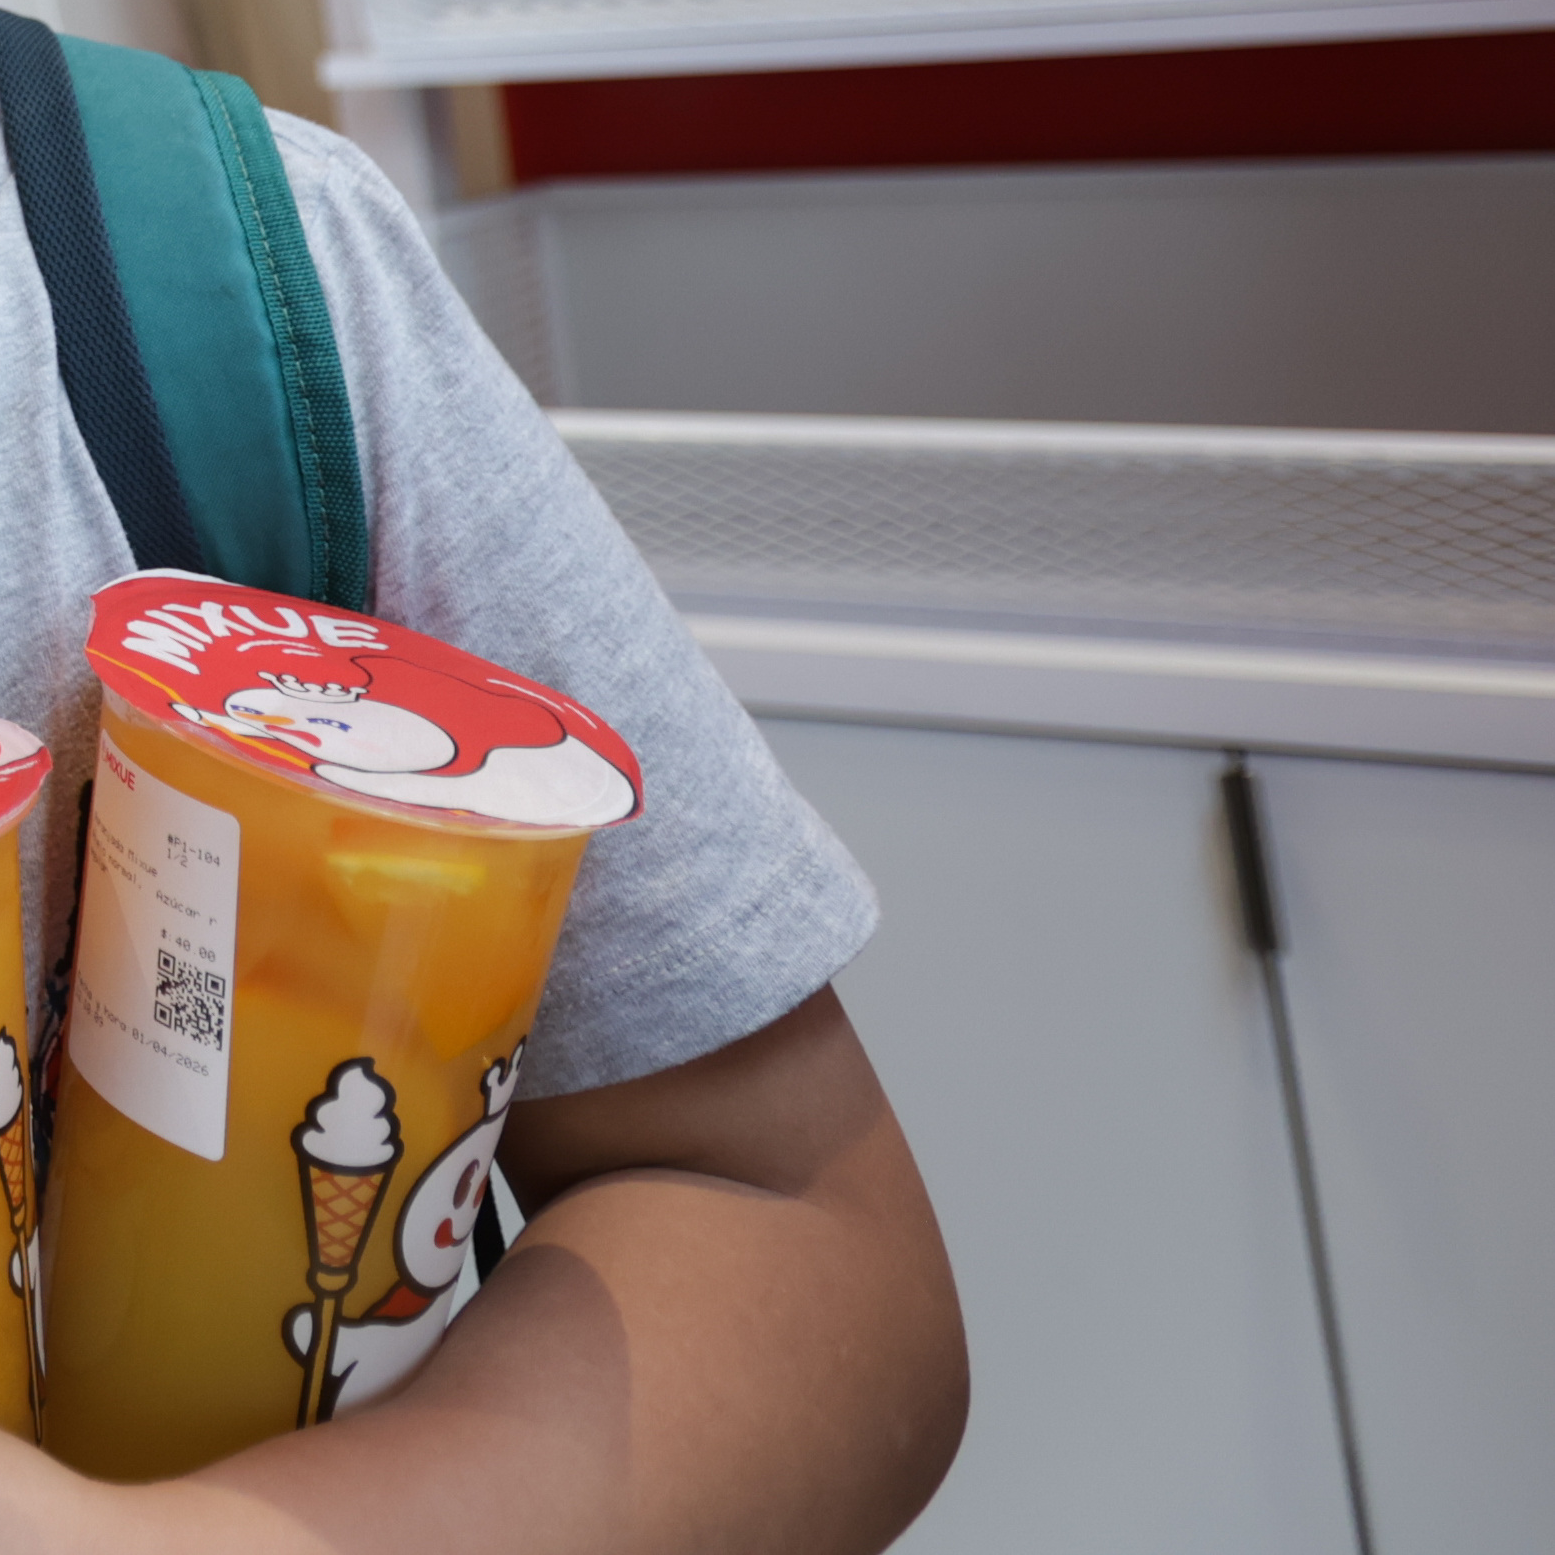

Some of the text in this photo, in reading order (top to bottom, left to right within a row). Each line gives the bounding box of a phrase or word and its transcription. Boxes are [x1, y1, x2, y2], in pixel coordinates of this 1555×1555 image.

[120, 600, 390, 675] MIXUE
[166, 848, 189, 868] 1/2
[167, 833, 221, 868] #P1-104
[155, 889, 201, 919] Azúcar
